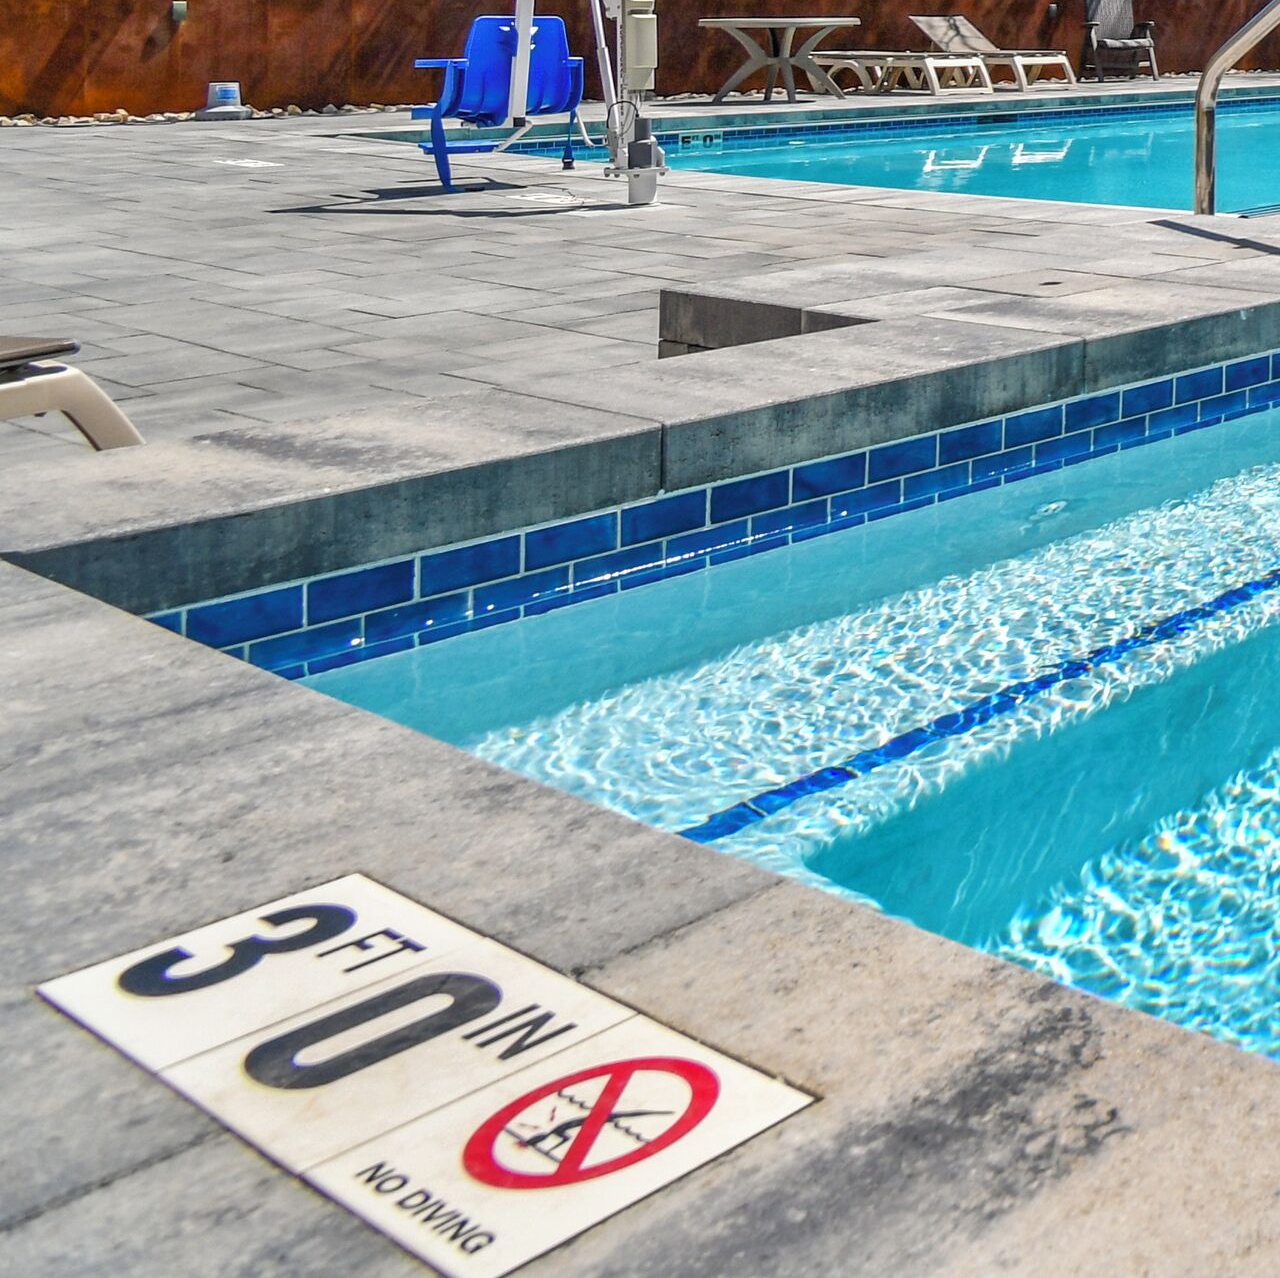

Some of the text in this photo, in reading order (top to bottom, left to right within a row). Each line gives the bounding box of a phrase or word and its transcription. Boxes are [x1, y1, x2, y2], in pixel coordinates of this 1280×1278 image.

[118, 902, 578, 1090] 3 FT 0 IN
[356, 1160, 494, 1256] NO DIVING
